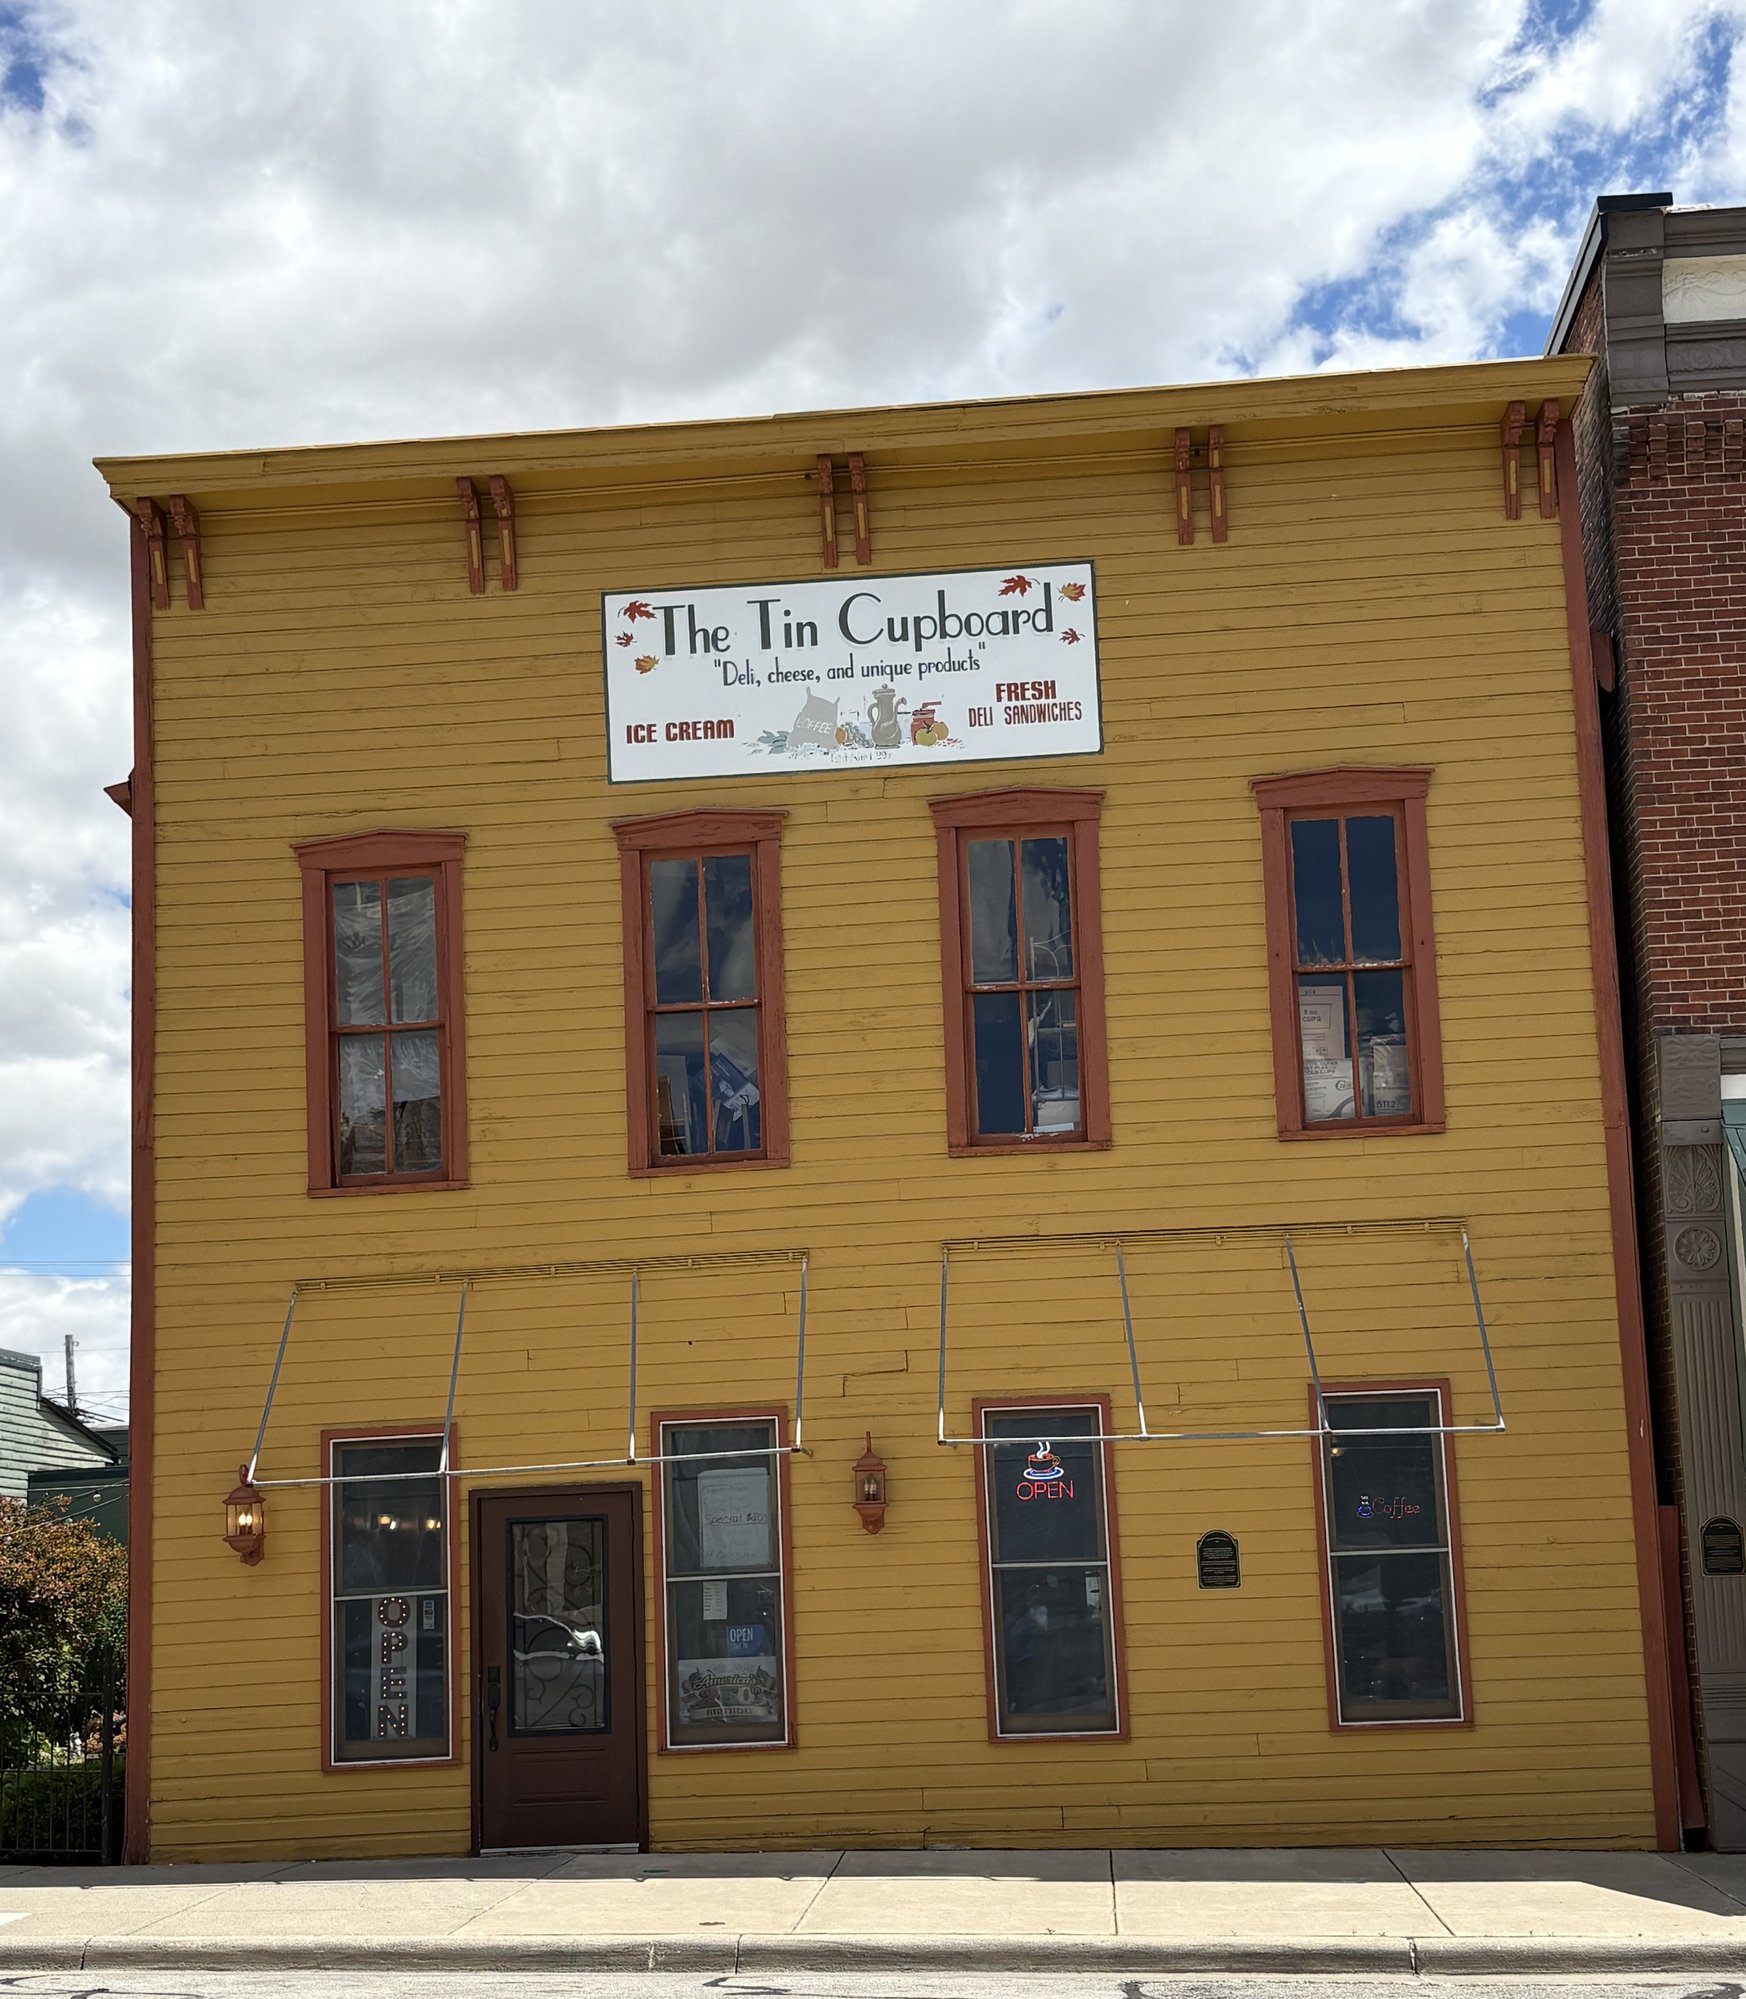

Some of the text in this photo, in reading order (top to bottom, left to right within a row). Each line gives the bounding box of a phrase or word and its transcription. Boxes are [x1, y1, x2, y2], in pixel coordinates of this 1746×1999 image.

[652, 582, 1054, 656] The Tin Cupboard
[714, 641, 986, 687] "Deli, cheese, and unique products"
[995, 680, 1057, 702] FRESH
[968, 701, 1082, 727] DELI SANDWICHES
[626, 718, 735, 744] ICE CREAM
[796, 717, 833, 735] COFFEE
[1016, 1480, 1074, 1501] OPEN
[1372, 1497, 1421, 1519] Coffee
[729, 1628, 753, 1643] OPEN
[378, 1596, 410, 1738] OPEN
[692, 1670, 757, 1692] America's
